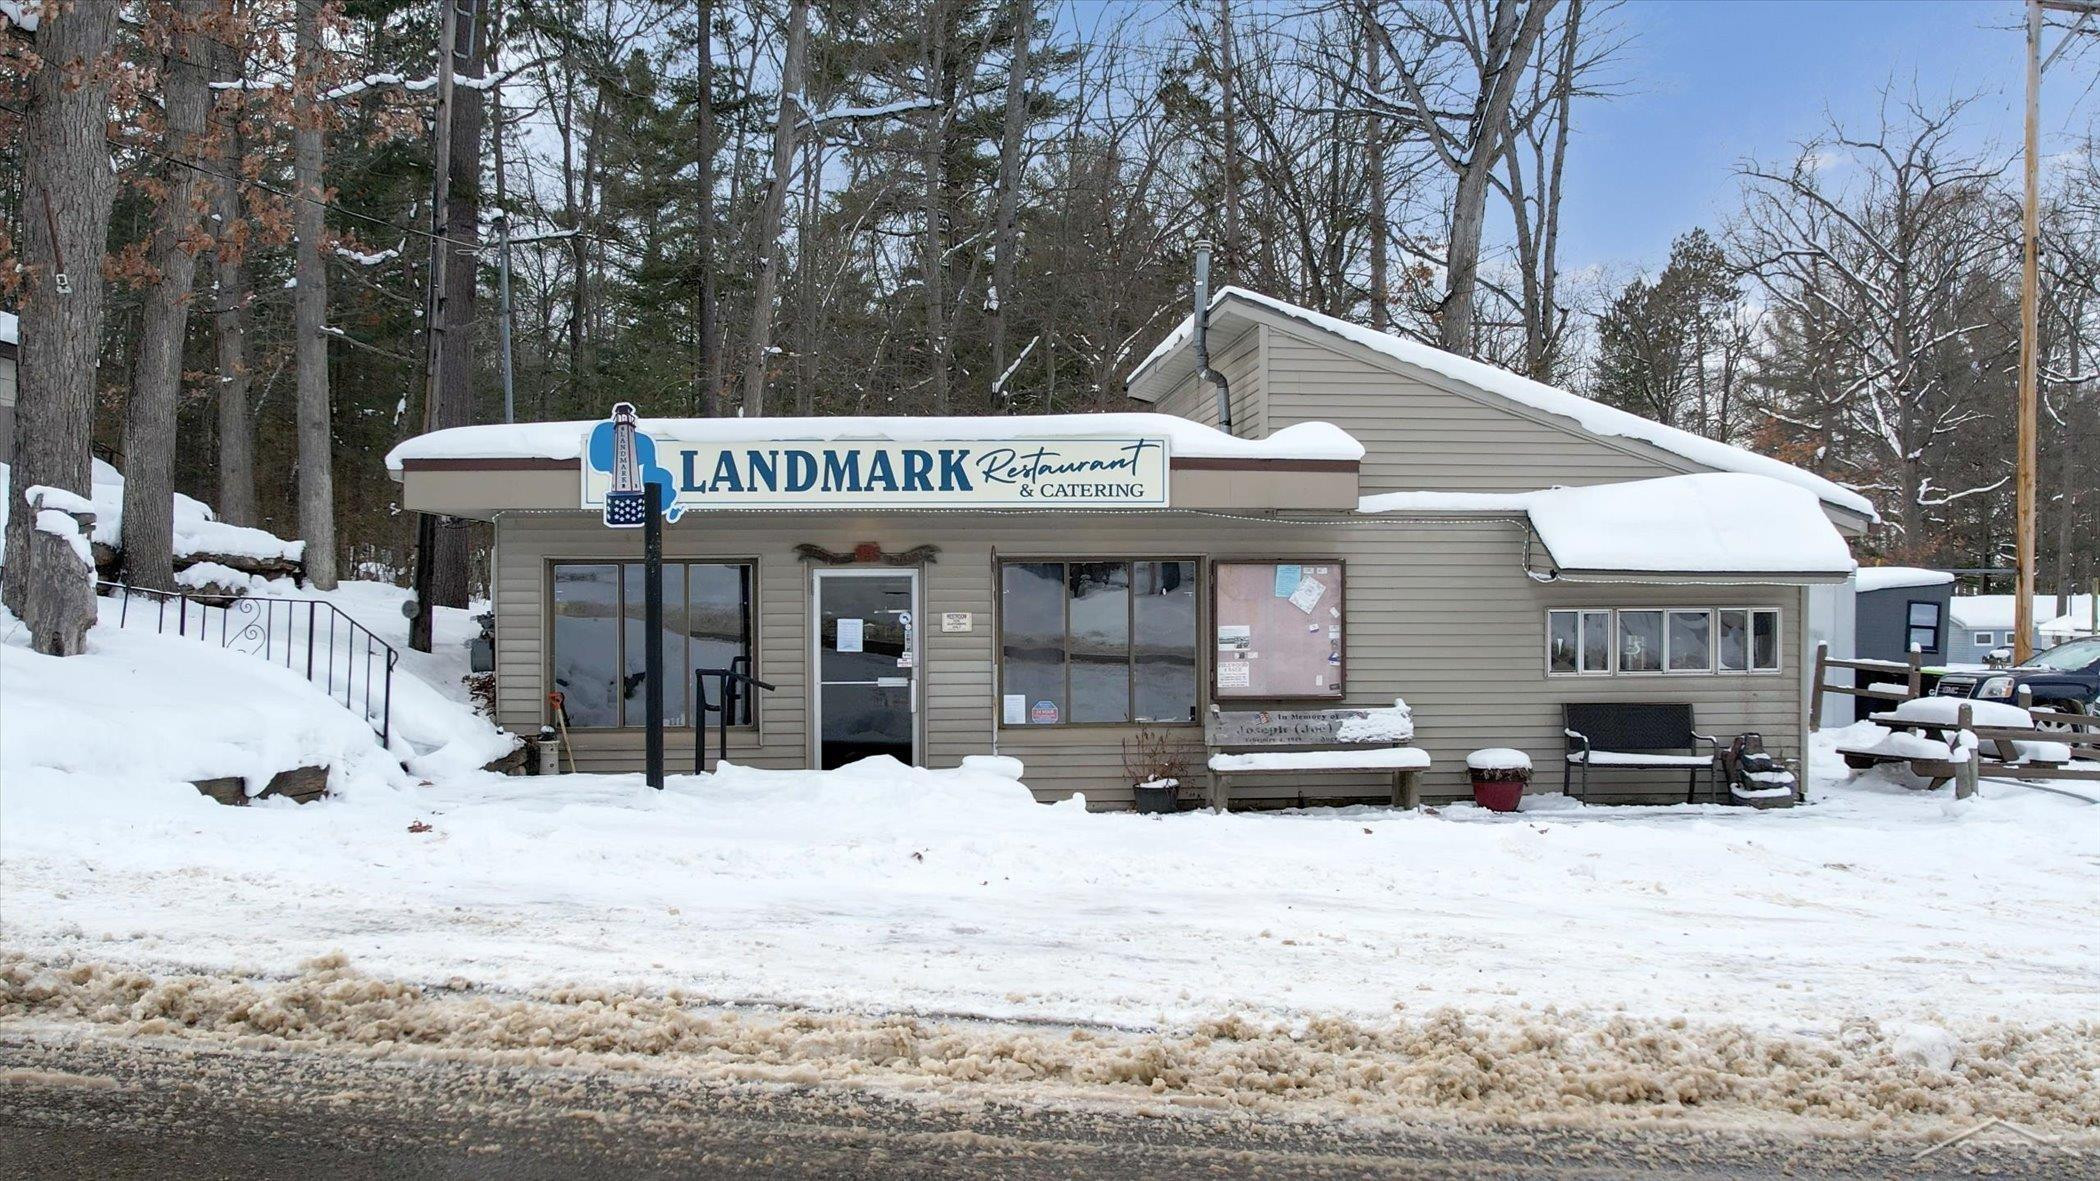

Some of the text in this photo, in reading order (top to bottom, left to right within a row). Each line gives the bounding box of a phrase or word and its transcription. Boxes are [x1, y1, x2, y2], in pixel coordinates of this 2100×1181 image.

[619, 431, 628, 484] LANDMARK
[680, 449, 973, 494] LANDMARK
[976, 438, 1160, 484] Restaurant
[1019, 483, 1144, 498] & CATERING
[1291, 713, 1327, 721] Memory
